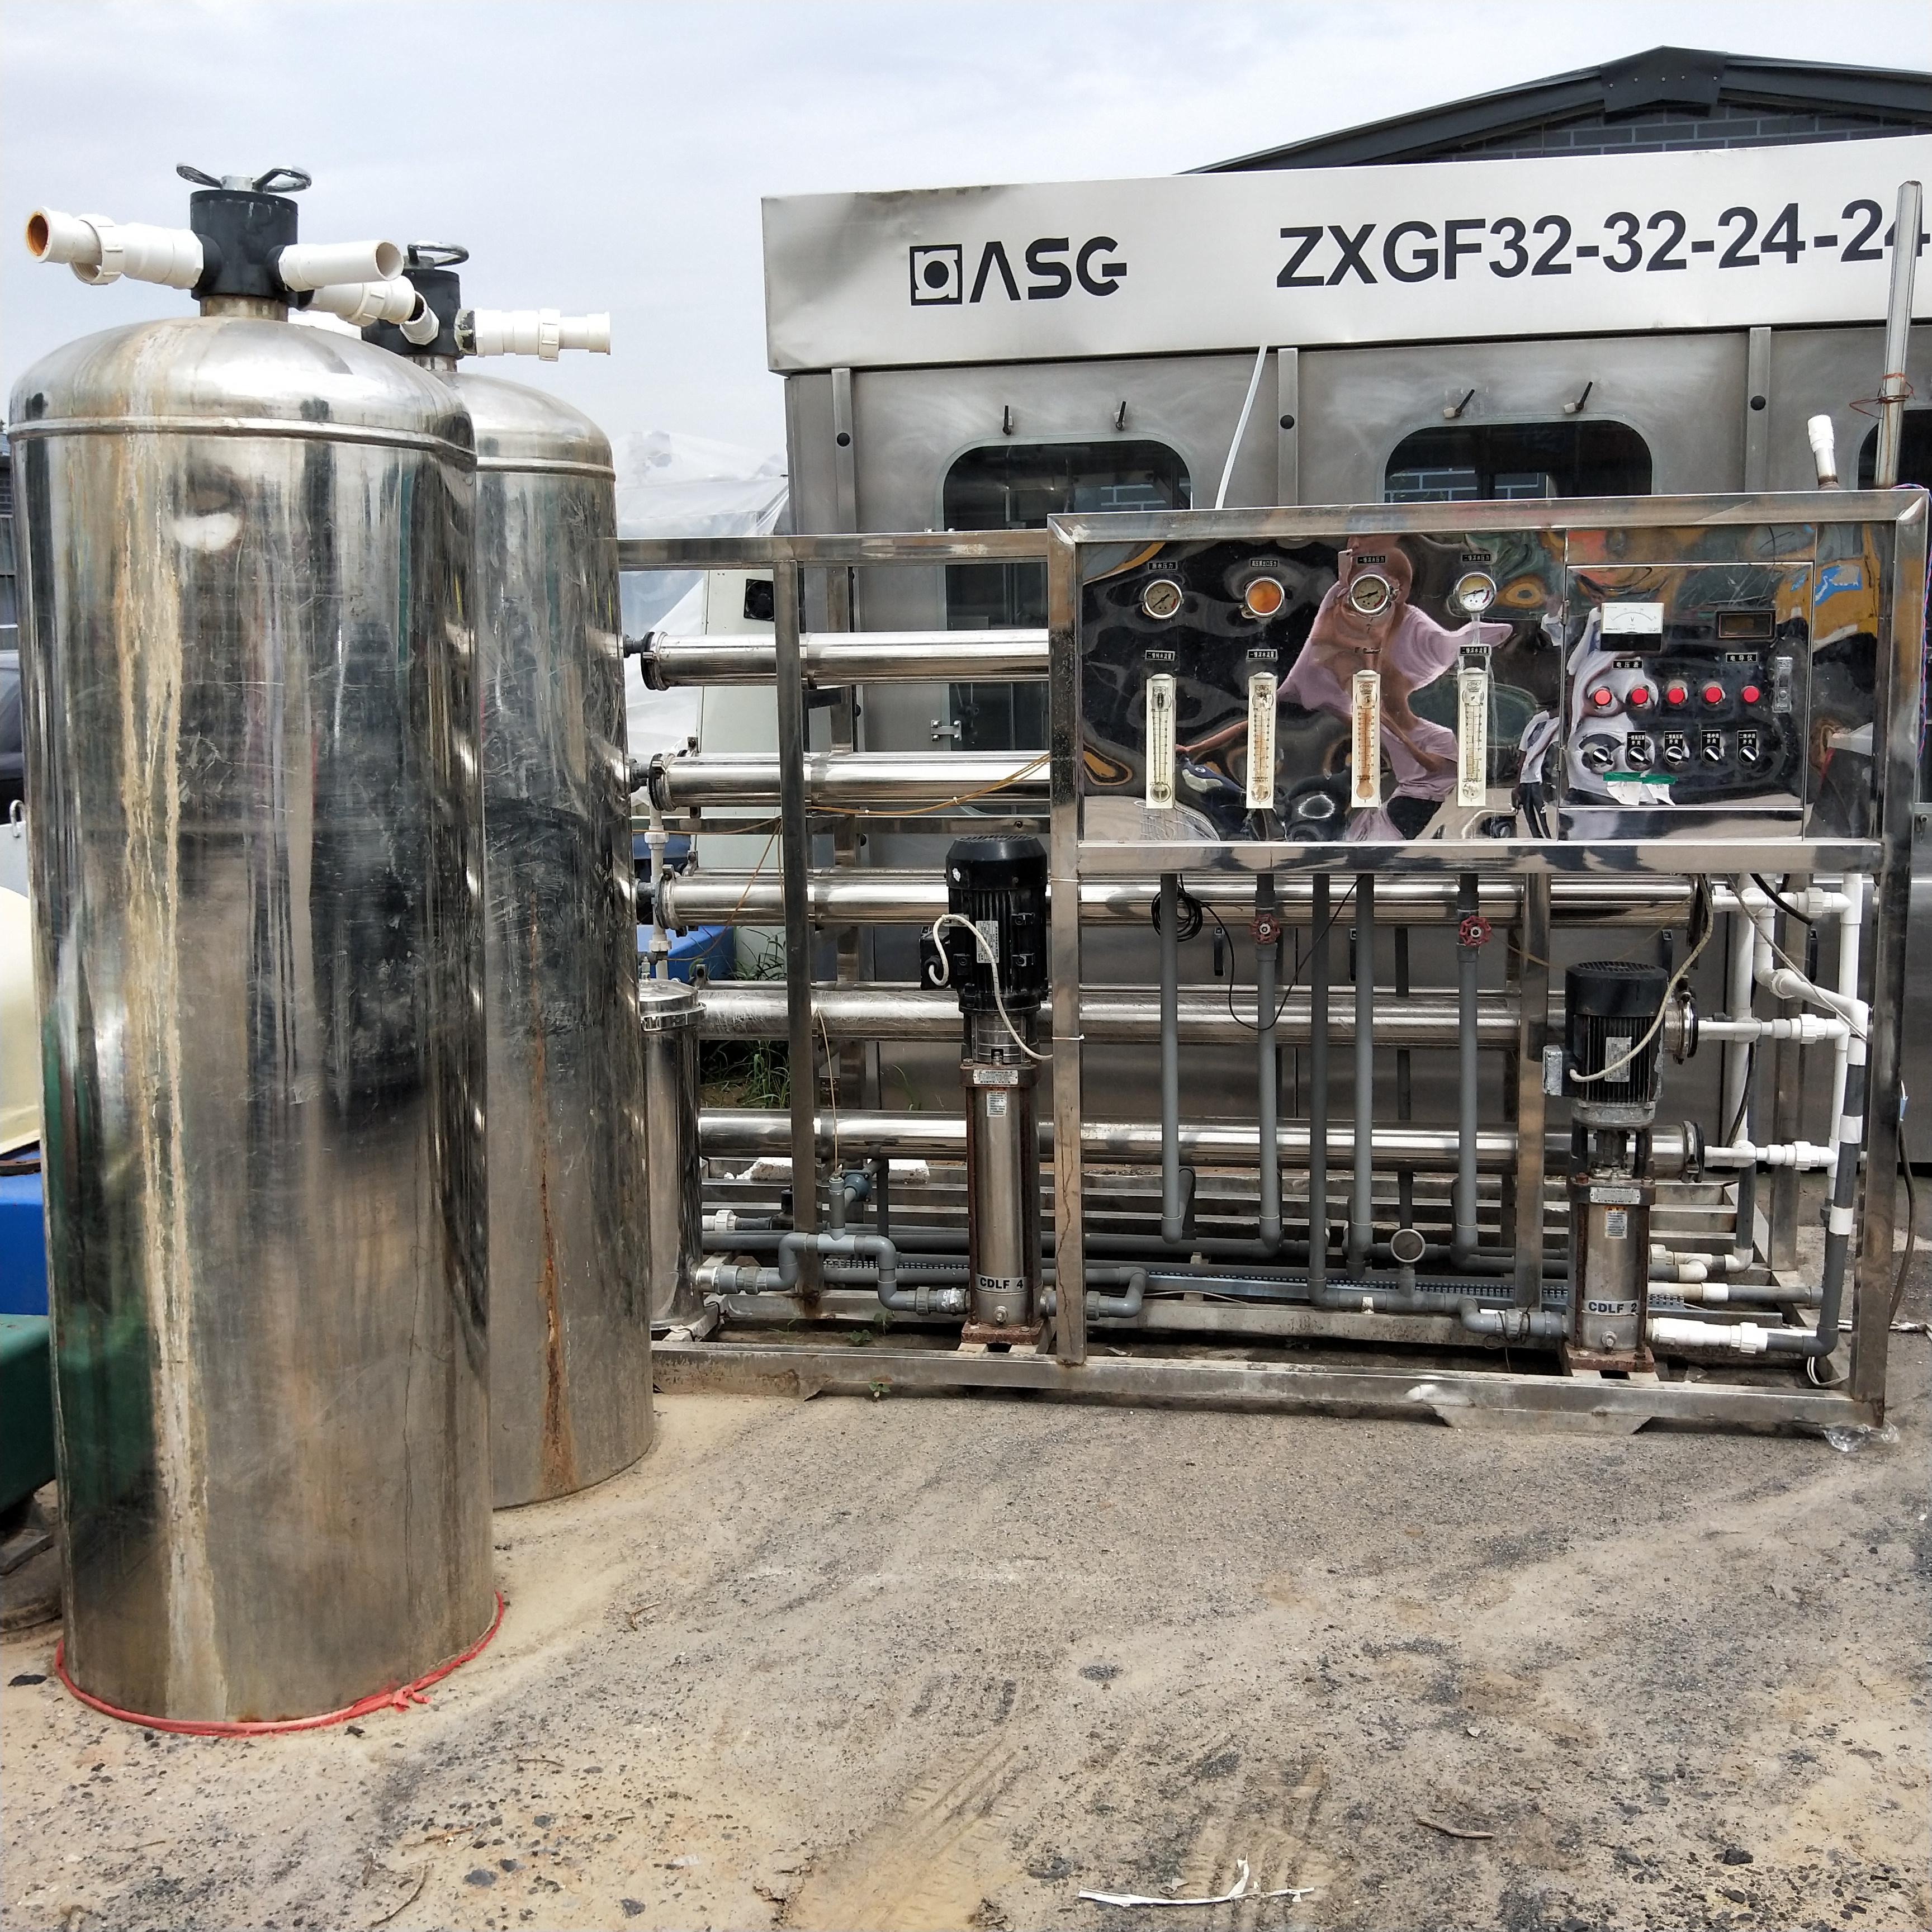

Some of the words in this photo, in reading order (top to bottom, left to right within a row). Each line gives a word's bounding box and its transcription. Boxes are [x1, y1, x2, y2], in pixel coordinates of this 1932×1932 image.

[969, 236, 1127, 303] ASG
[980, 1277, 1010, 1289] CDLF
[1016, 1279, 1024, 1289] 4
[1588, 1301, 1624, 1313] CDLF
[1631, 1303, 1637, 1313] 2
